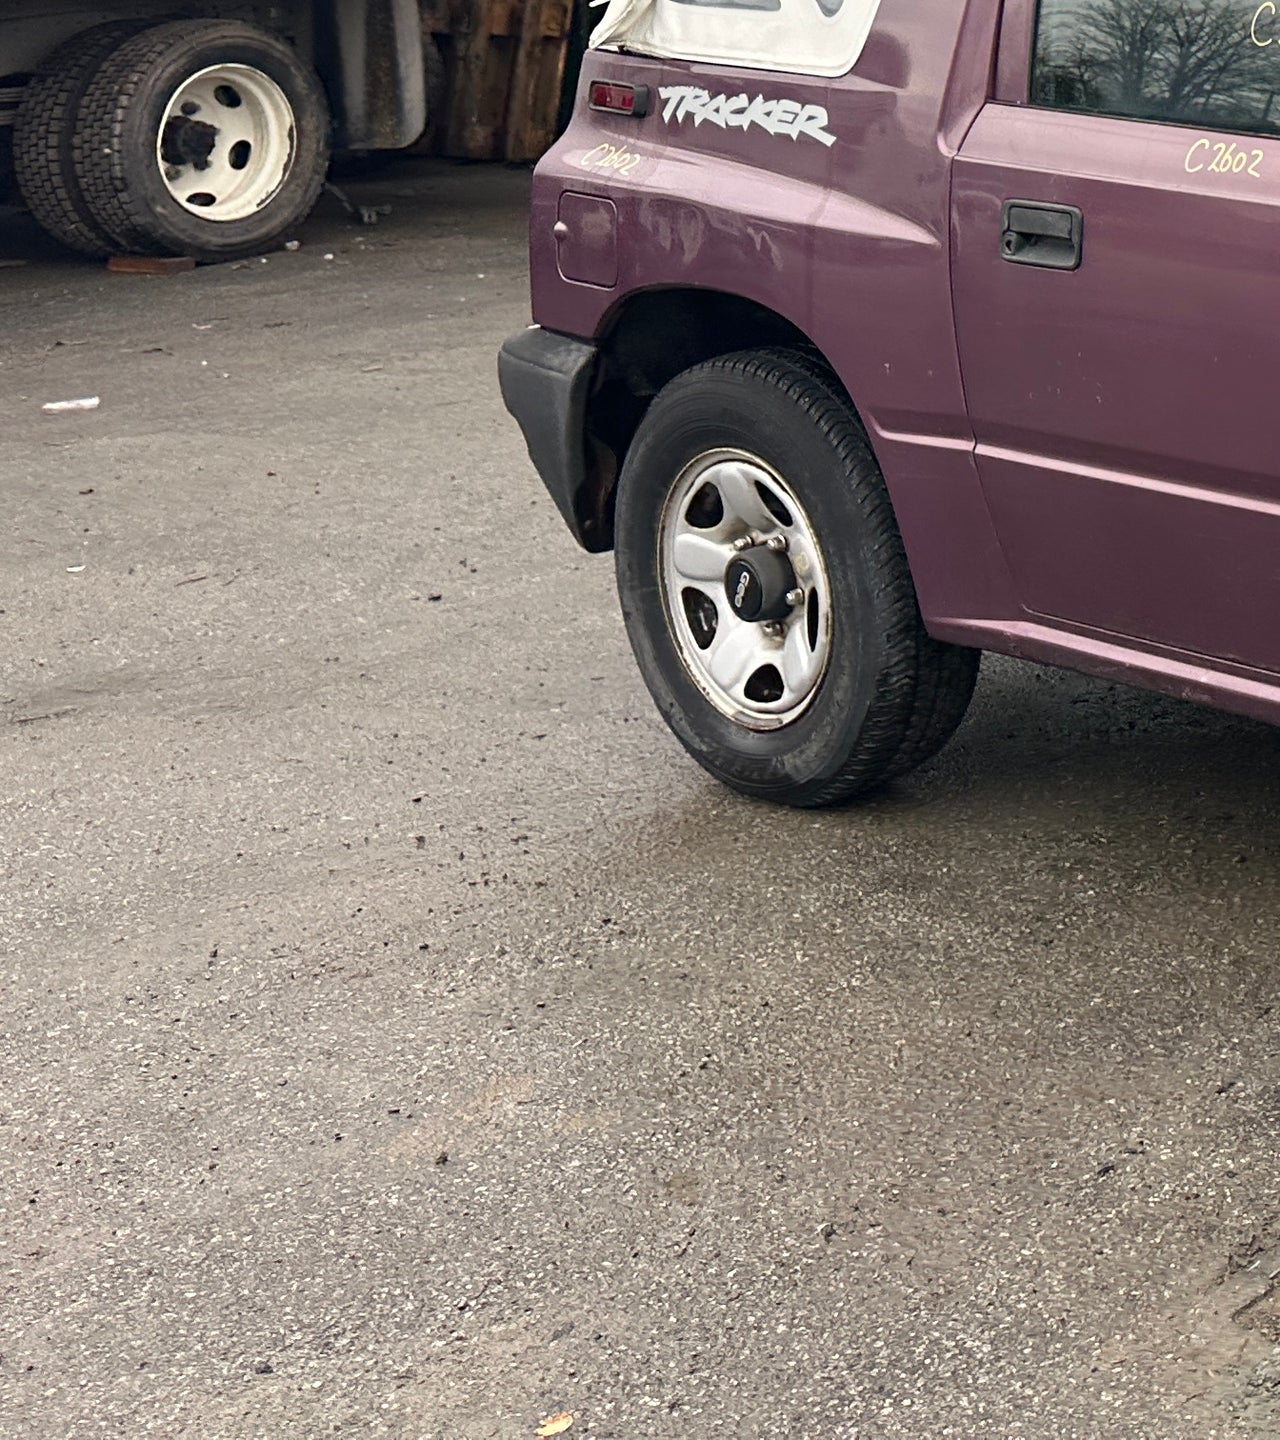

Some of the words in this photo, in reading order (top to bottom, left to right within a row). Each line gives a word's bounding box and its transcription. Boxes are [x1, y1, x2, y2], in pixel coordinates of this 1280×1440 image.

[658, 85, 837, 147] TRACKER
[581, 142, 642, 176] C2602
[1184, 138, 1264, 178] C2602
